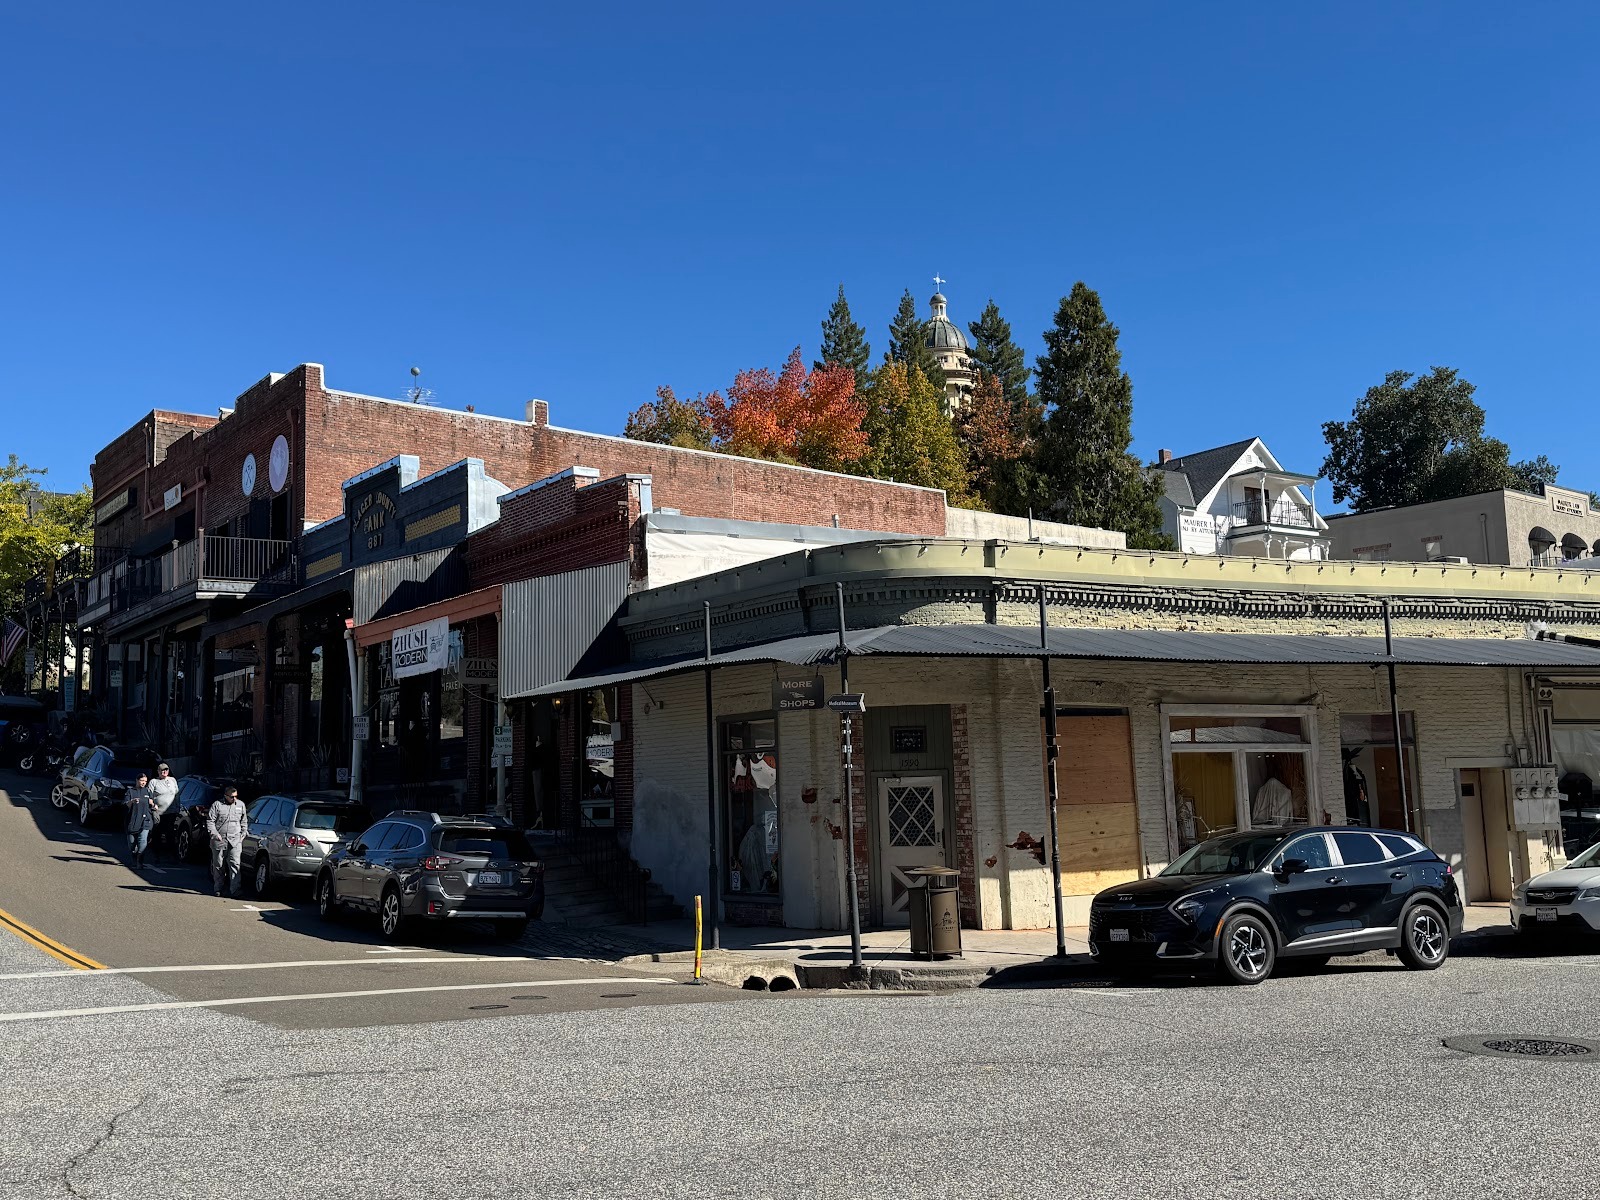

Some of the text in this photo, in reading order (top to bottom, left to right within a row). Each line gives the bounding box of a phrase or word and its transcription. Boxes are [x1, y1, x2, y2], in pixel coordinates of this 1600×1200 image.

[1184, 519, 1208, 528] MAURER
[395, 650, 429, 668] MODERN
[467, 670, 498, 678] MODER
[782, 680, 813, 689] MORE
[780, 699, 816, 708] SHOPS
